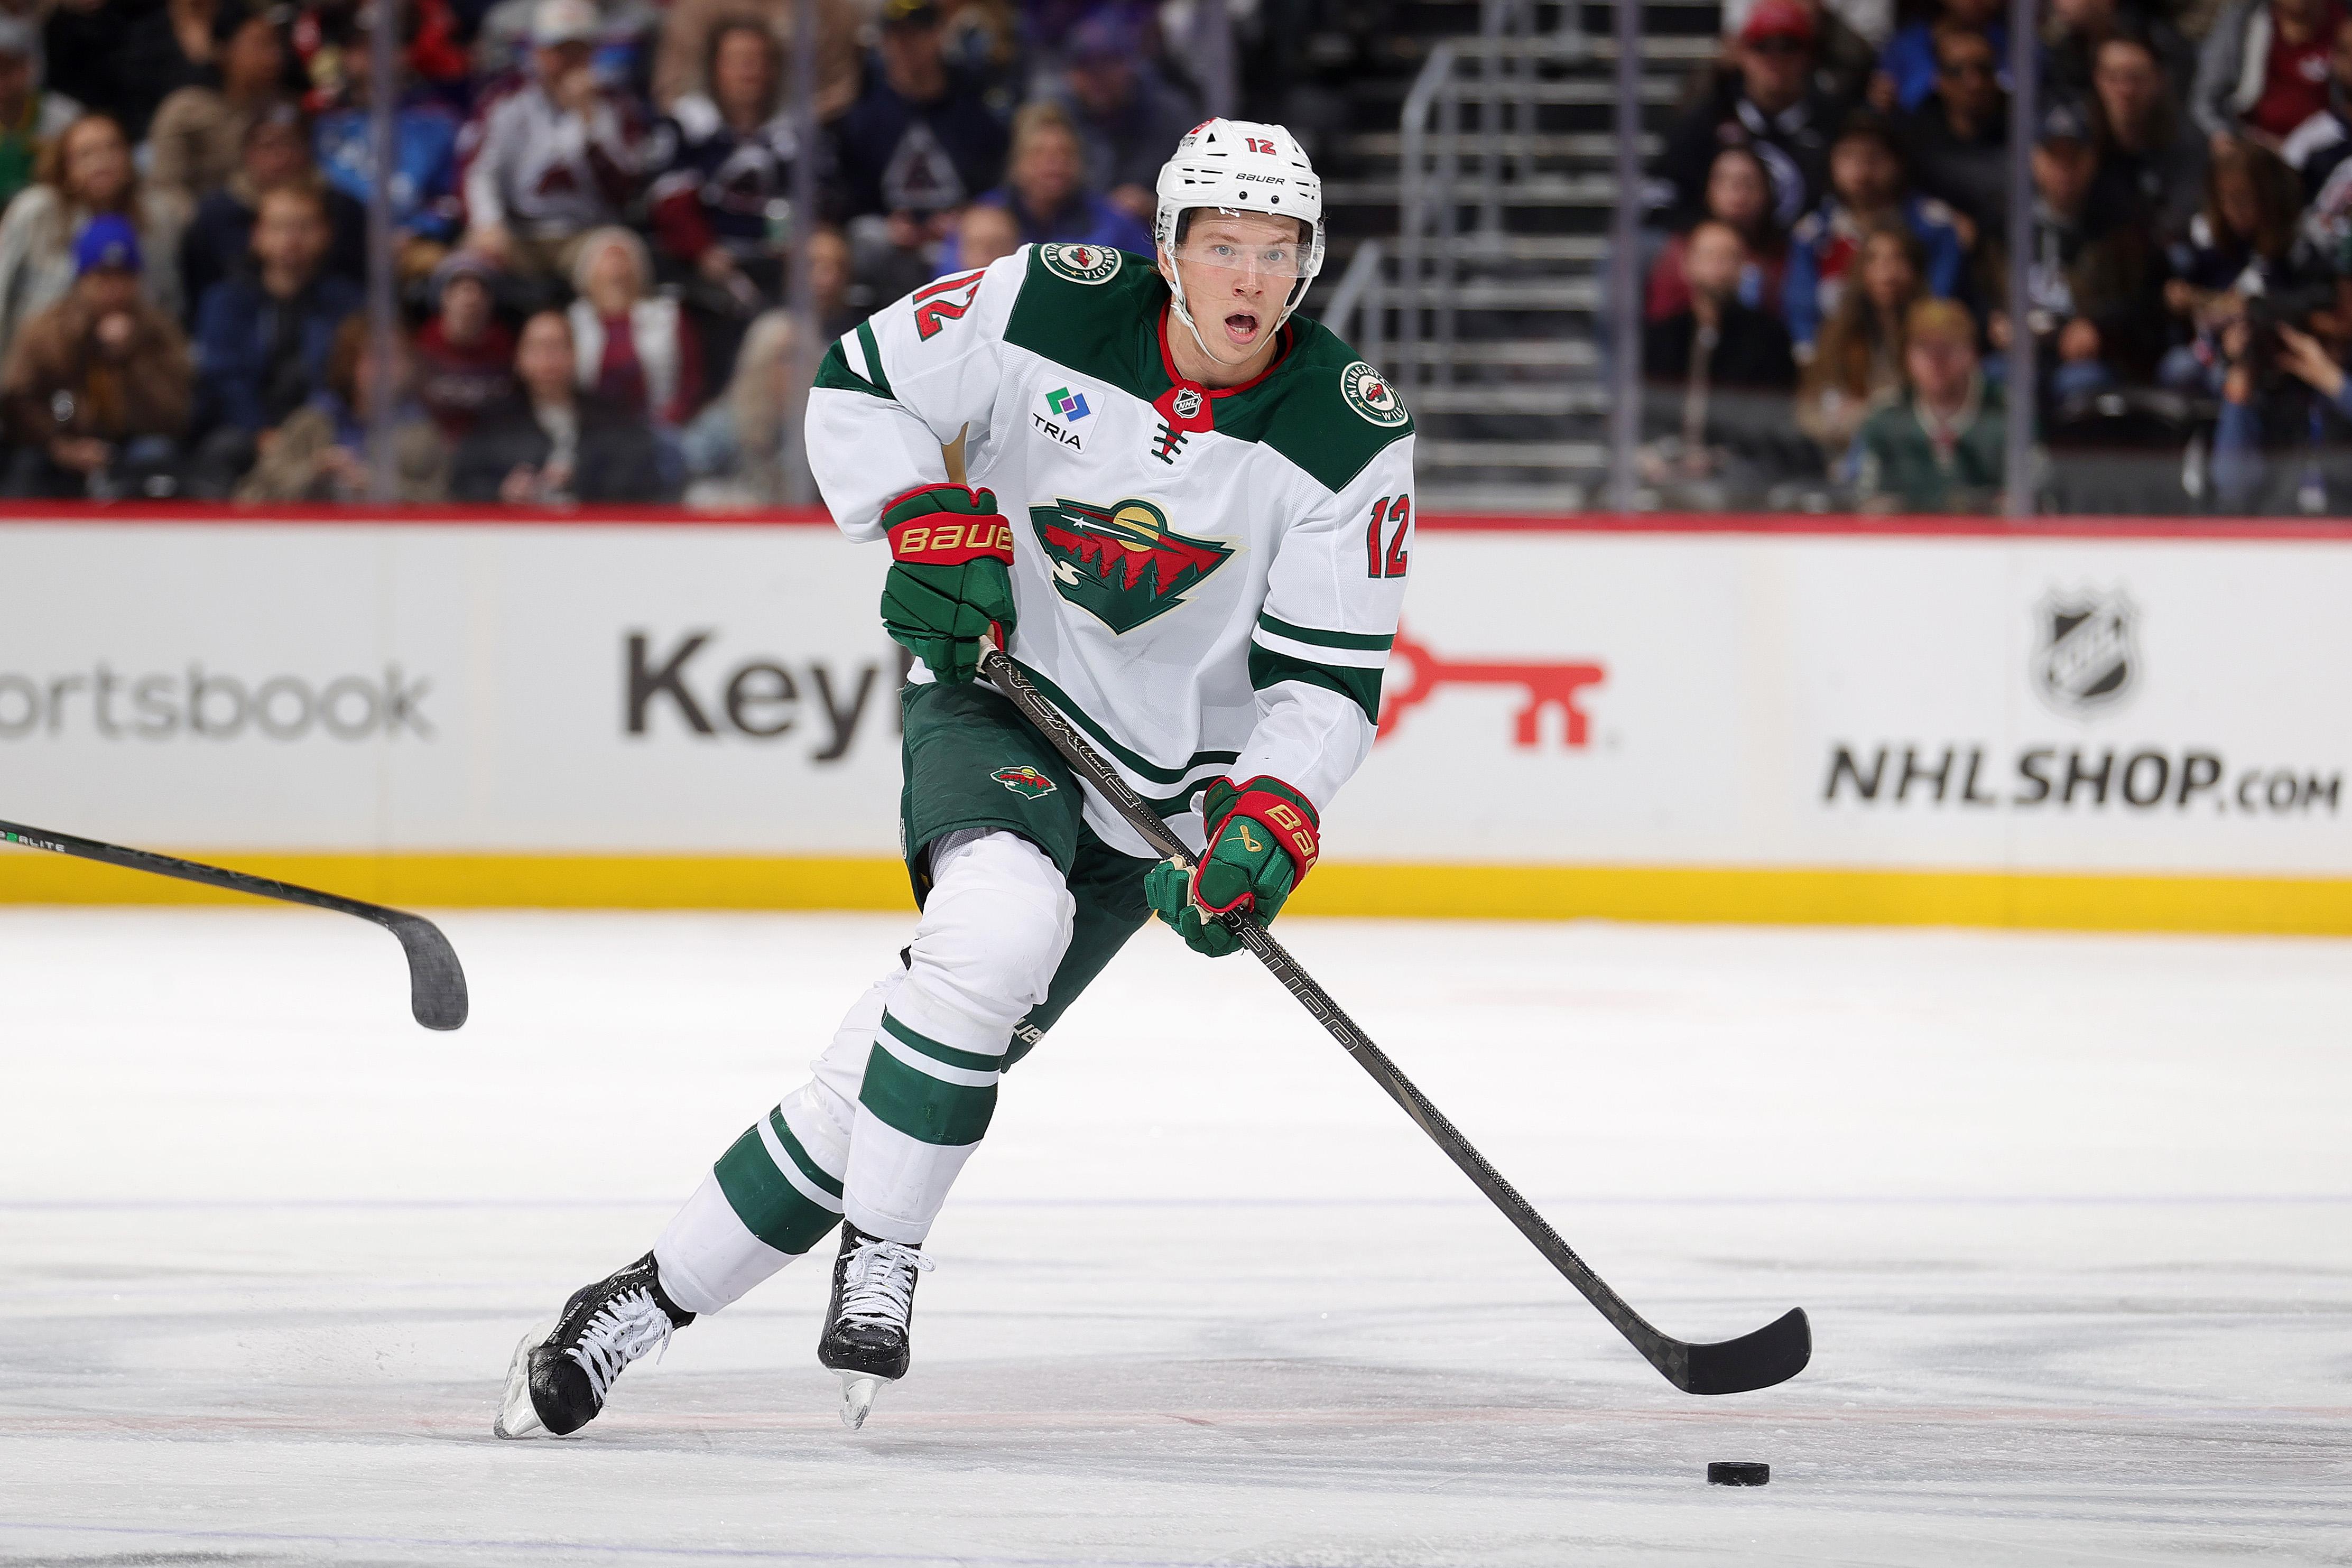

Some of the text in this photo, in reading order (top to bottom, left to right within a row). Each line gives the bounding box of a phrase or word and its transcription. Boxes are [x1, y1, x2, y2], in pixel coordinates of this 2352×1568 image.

[1245, 138, 1277, 156] 12
[913, 268, 988, 342] 12
[1178, 400, 1196, 410] NHL
[1346, 365, 1404, 421] MINNESOTA WILD
[1032, 412, 1081, 450] TRIA
[899, 523, 1015, 554] BAUE
[1366, 494, 1411, 579] 12
[0, 660, 438, 741] ortsbook
[625, 630, 912, 761] Key
